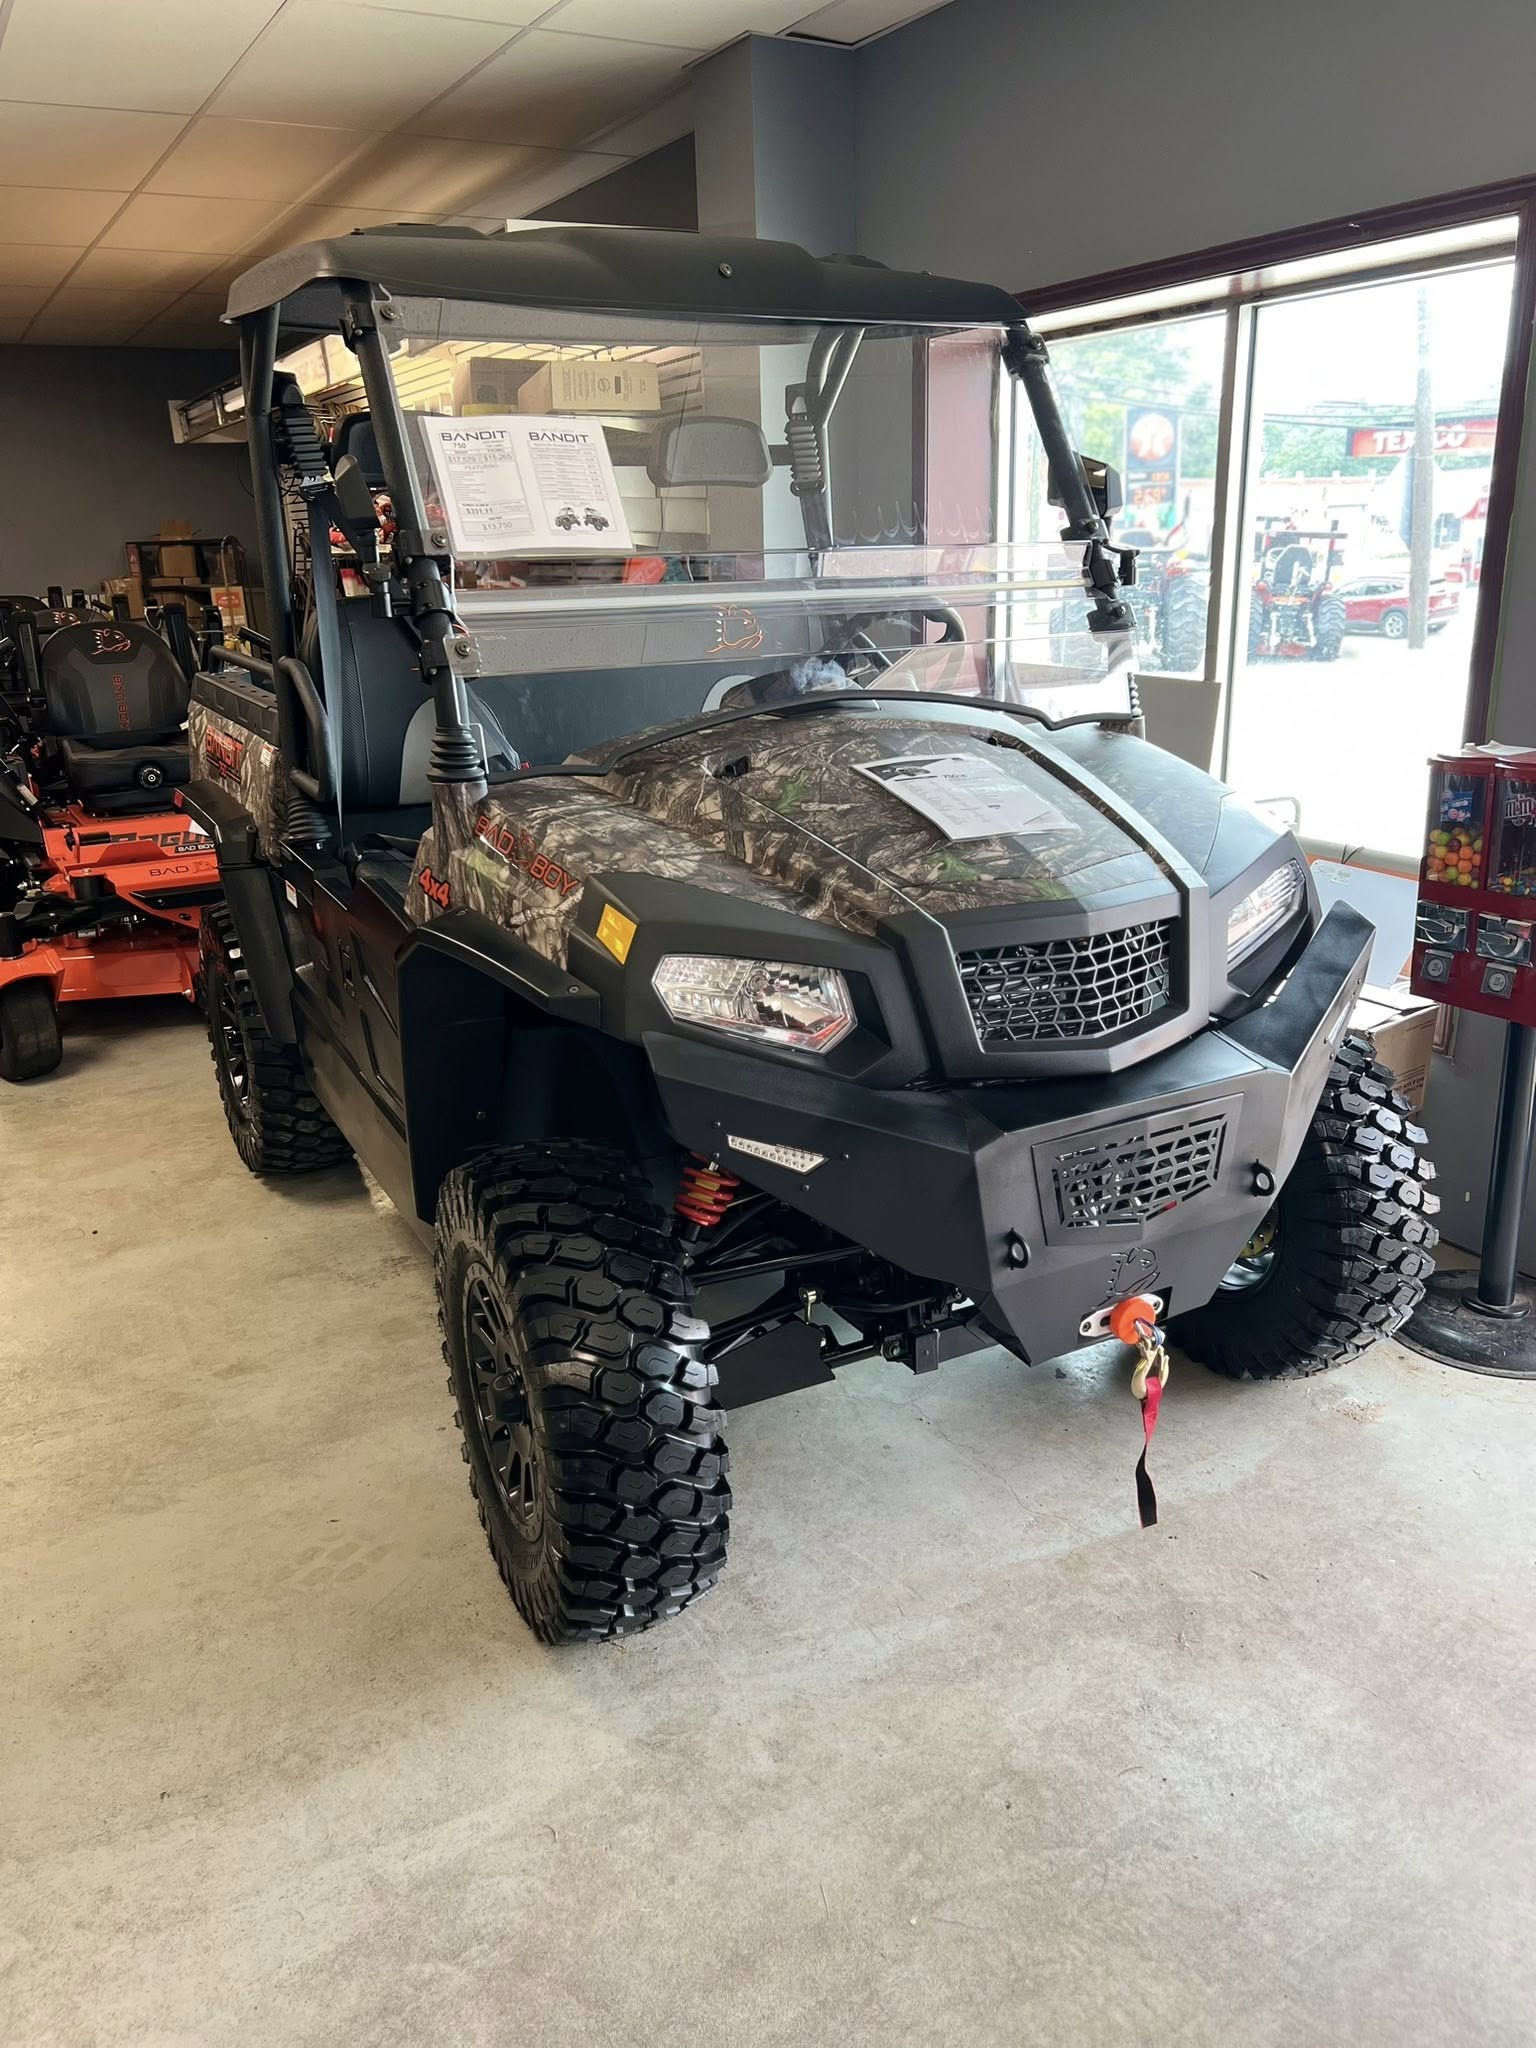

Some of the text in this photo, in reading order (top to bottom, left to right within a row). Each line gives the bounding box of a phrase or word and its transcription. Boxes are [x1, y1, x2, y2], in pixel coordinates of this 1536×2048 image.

[441, 430, 507, 442] BANDIT
[528, 432, 589, 443] BANDIT
[178, 842, 215, 852] BAD BOY
[475, 815, 580, 897] BAD BOY
[149, 865, 189, 876] BAD
[418, 866, 451, 910] 4x4
